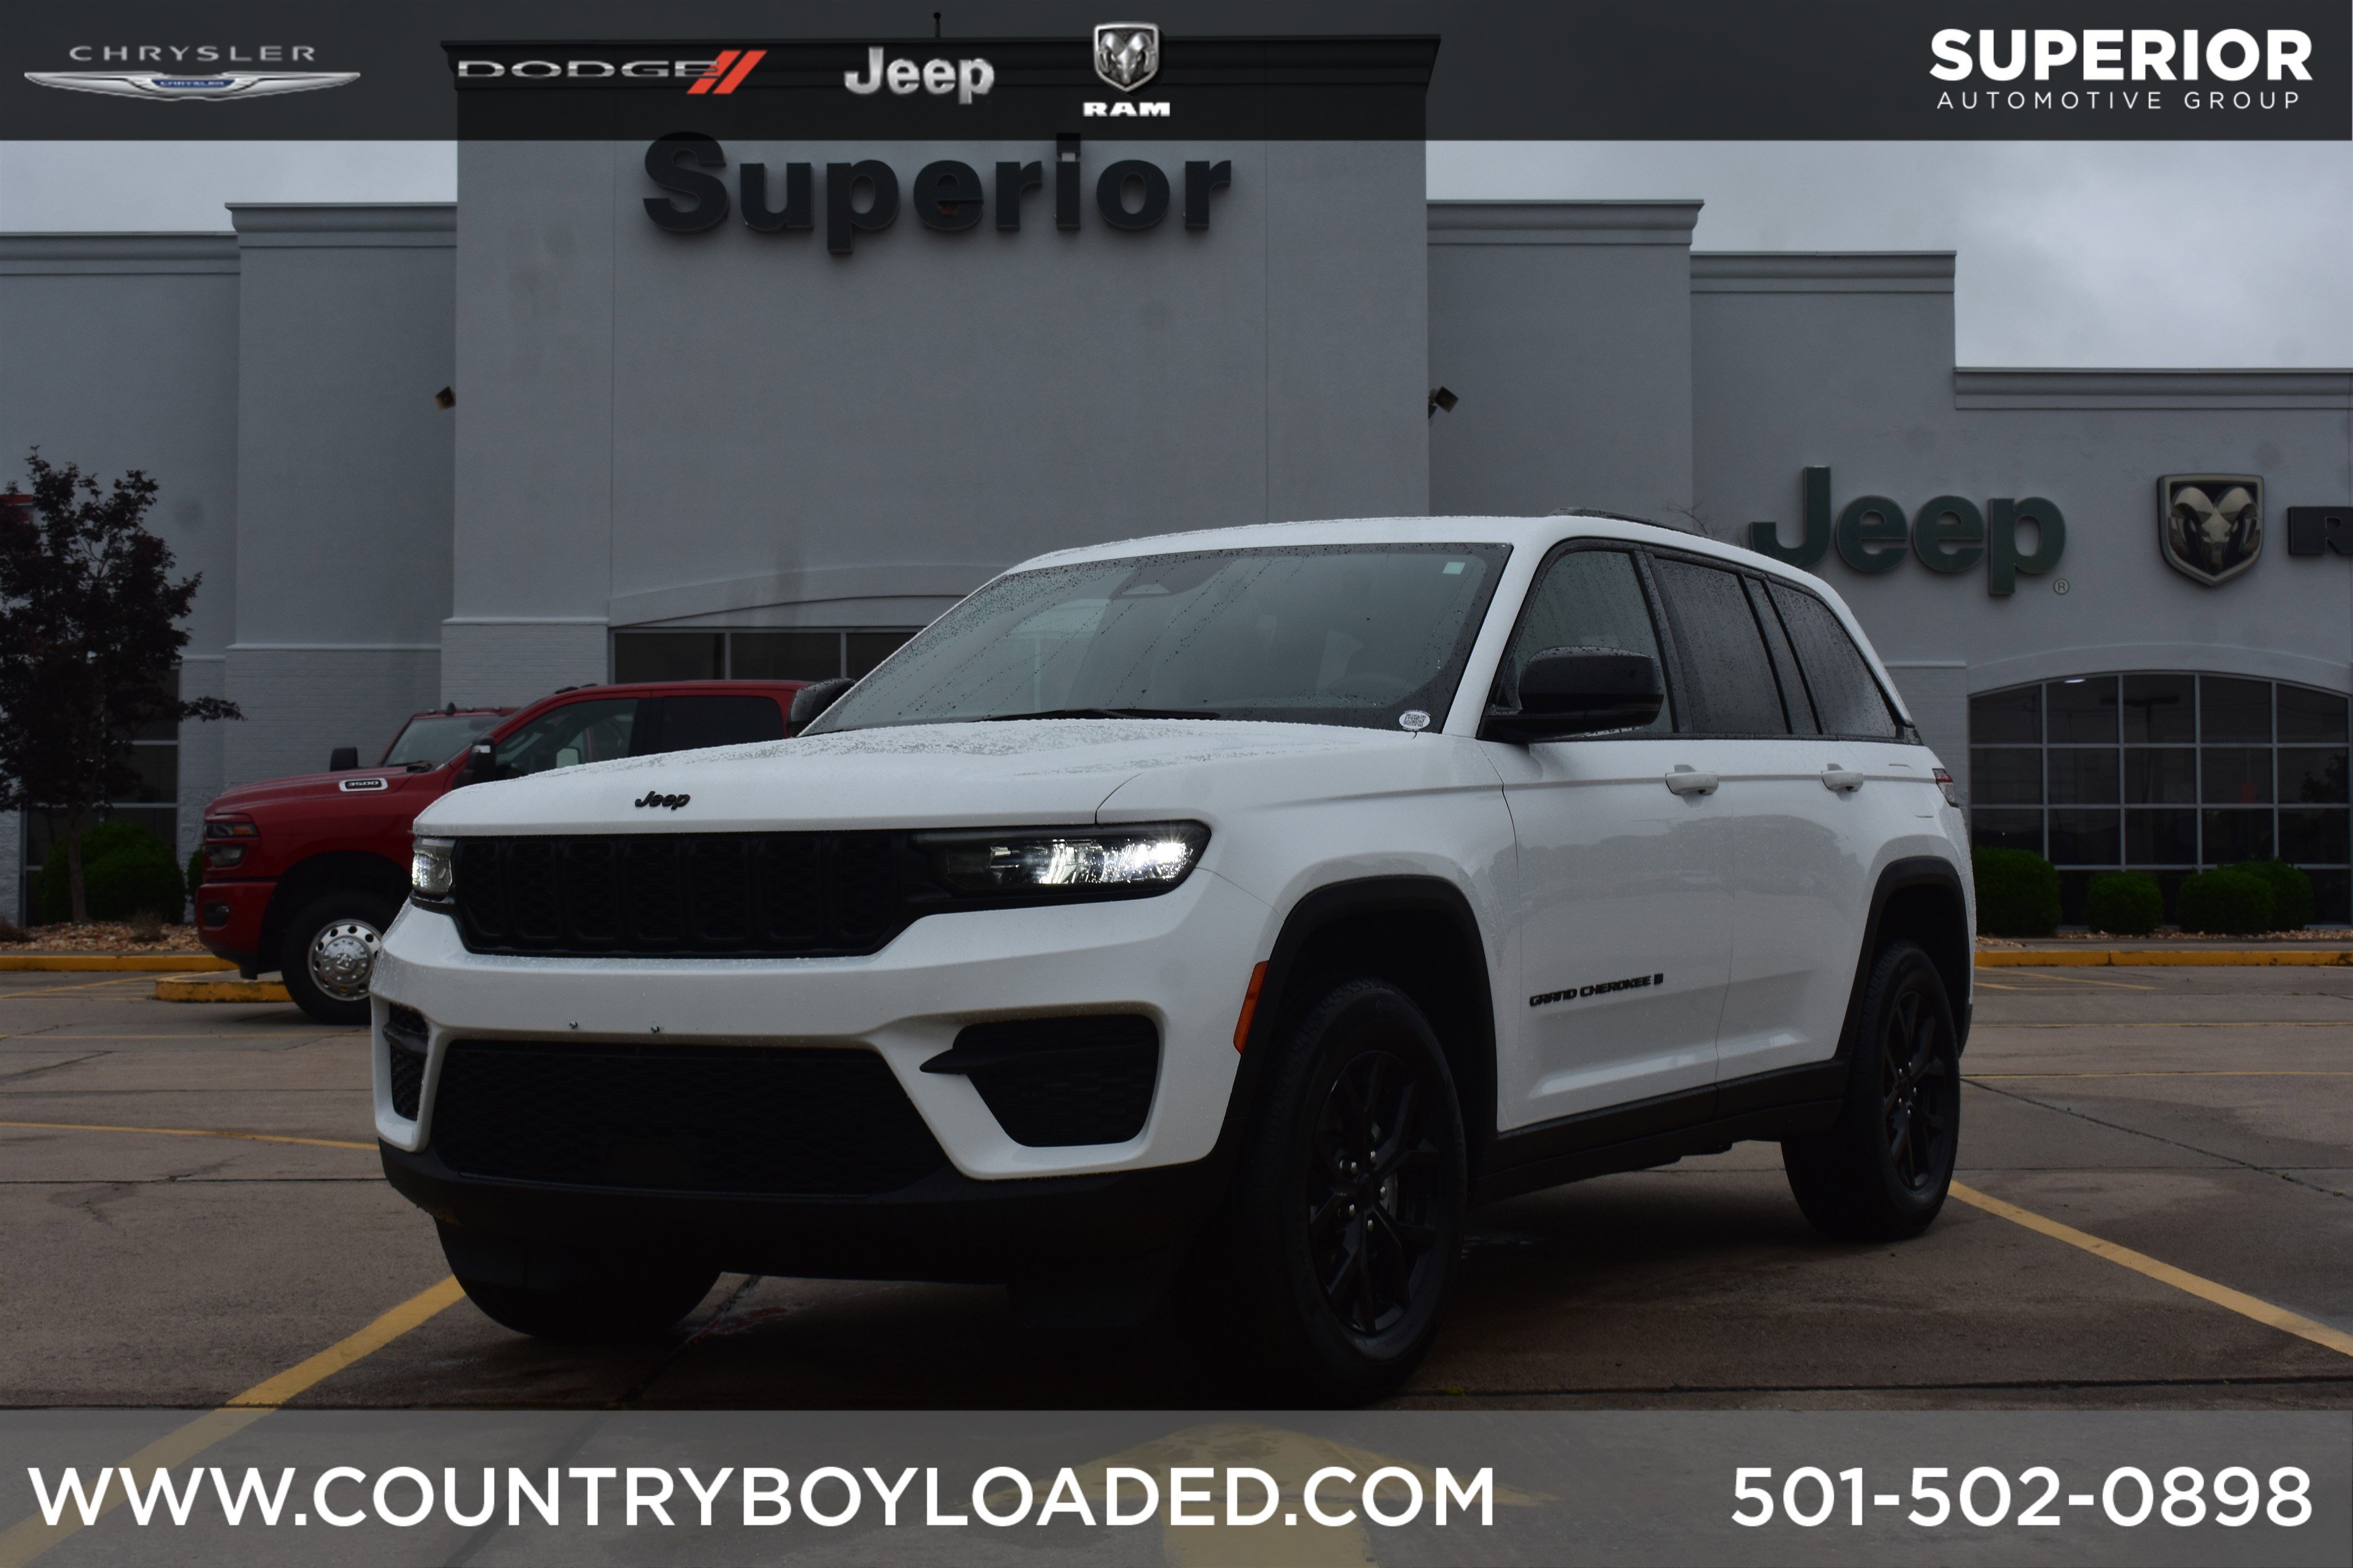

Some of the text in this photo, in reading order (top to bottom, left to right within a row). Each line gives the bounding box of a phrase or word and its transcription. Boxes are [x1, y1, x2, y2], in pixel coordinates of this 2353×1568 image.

[643, 132, 1232, 254] Superior
[1750, 466, 2066, 595] Jeep
[634, 791, 691, 811] Jeep
[1529, 975, 1652, 1007] GRAND CHEROKEE
